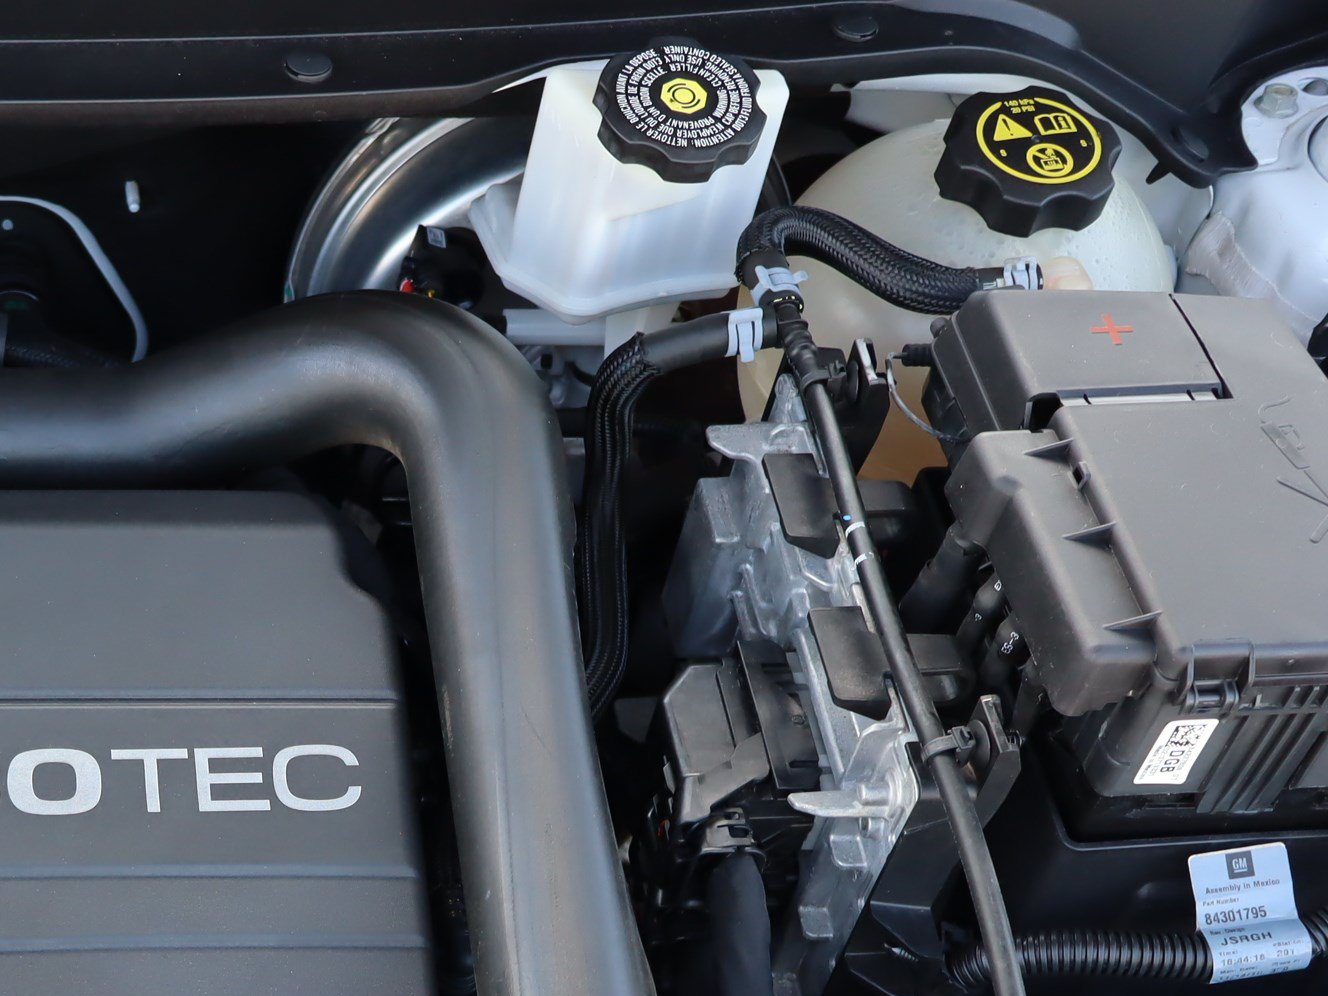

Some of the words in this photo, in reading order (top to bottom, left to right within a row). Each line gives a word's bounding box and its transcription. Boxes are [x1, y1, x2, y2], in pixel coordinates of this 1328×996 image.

[663, 54, 685, 64] ONLY
[686, 55, 703, 66] USE
[709, 54, 737, 75] SEALED
[622, 65, 634, 74] LA
[629, 67, 647, 85] FREIN
[669, 63, 699, 74] FILLER
[616, 73, 628, 93] AVANT
[698, 67, 722, 87] CLEAN
[627, 85, 638, 94] DE
[735, 78, 751, 96] FROM
[640, 86, 652, 107] BIDON
[728, 90, 741, 114] BEFORE
[616, 94, 639, 124] BOUCHON
[628, 95, 648, 119] LIQUIDE
[740, 97, 752, 116] FLUID
[635, 121, 648, 132] LE
[645, 117, 658, 127] DU
[666, 116, 715, 129] PROVENANT
[721, 112, 736, 125] CAP
[657, 123, 674, 135] QUE
[646, 128, 688, 147] NETTOYER
[1160, 750, 1185, 772] DGB
[1232, 858, 1248, 871] GM
[1205, 884, 1241, 894] Assembly
[1253, 879, 1280, 887] Mexico
[1205, 905, 1268, 925] 84301795
[1221, 931, 1273, 946] JSRGH
